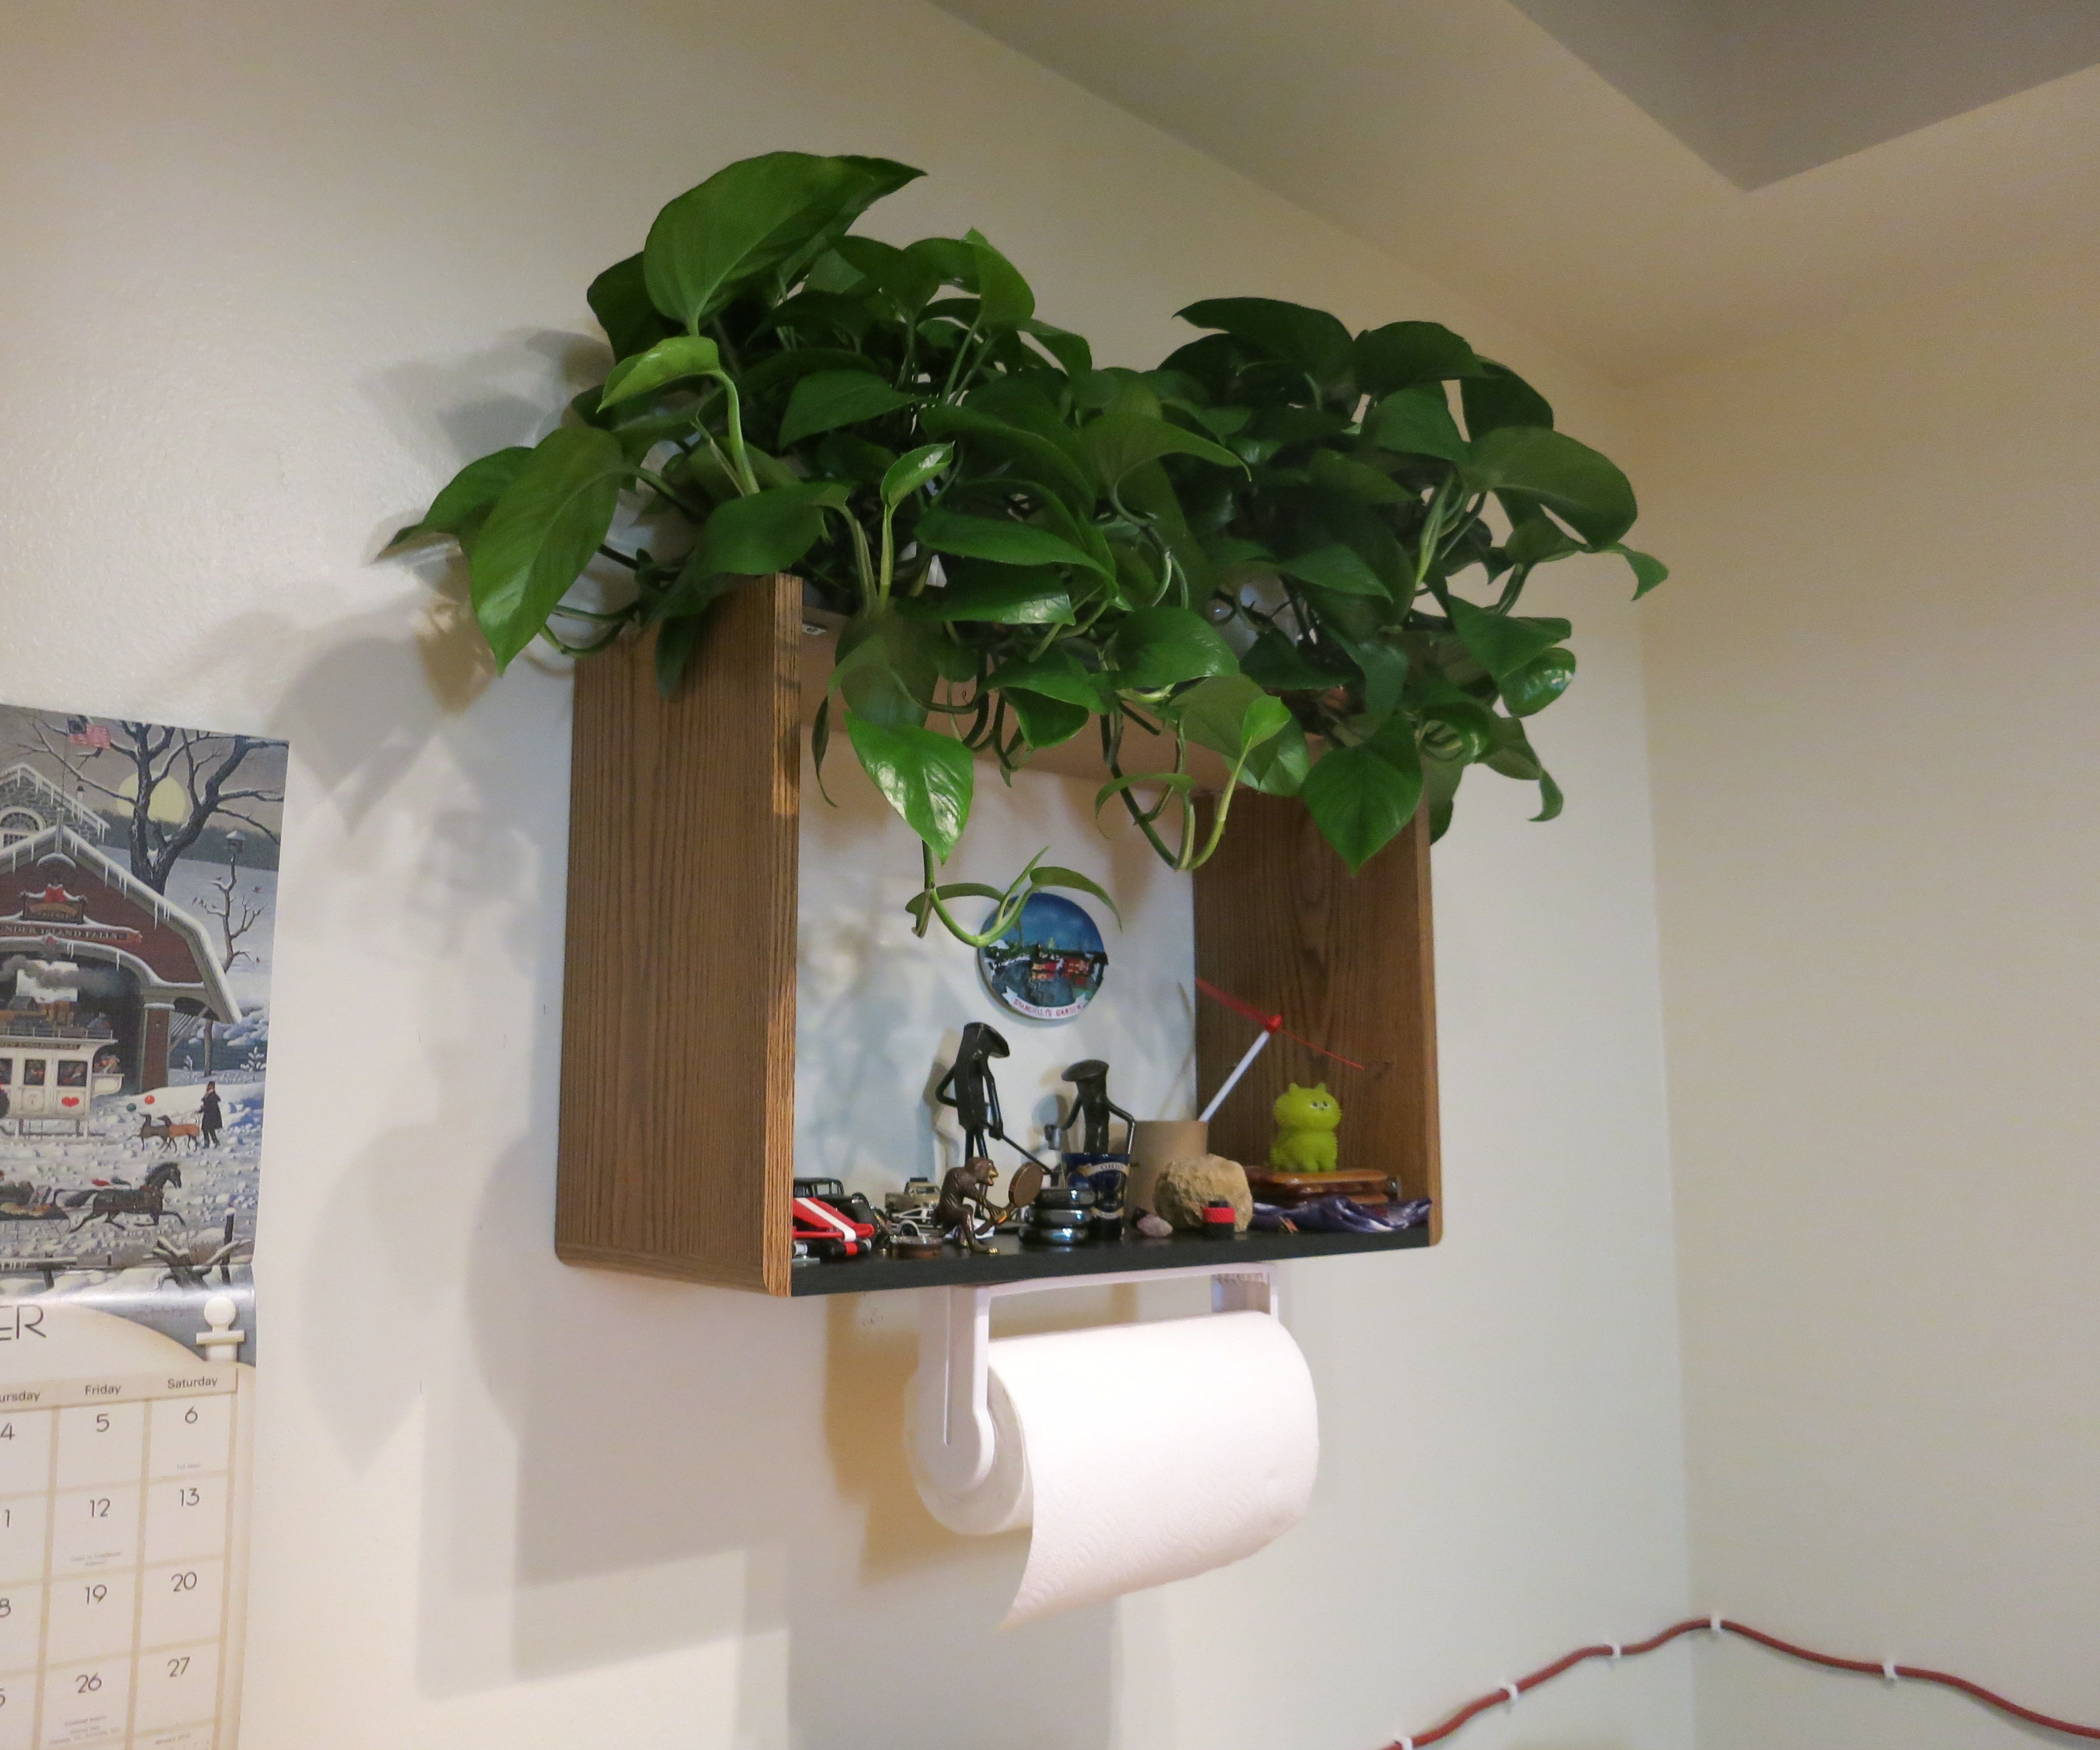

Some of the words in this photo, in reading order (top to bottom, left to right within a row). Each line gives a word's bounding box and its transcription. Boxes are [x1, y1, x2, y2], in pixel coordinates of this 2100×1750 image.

[85, 1384, 121, 1395] Friday
[167, 1376, 218, 1389] Saturday
[96, 1413, 110, 1432] 5
[185, 1406, 198, 1424] 6
[0, 1422, 15, 1440] 4
[180, 1488, 200, 1506] 13
[90, 1498, 110, 1517] 12
[171, 1572, 197, 1592] 20
[85, 1584, 107, 1605] 19
[167, 1656, 190, 1678] 27
[76, 1672, 102, 1693] 26
